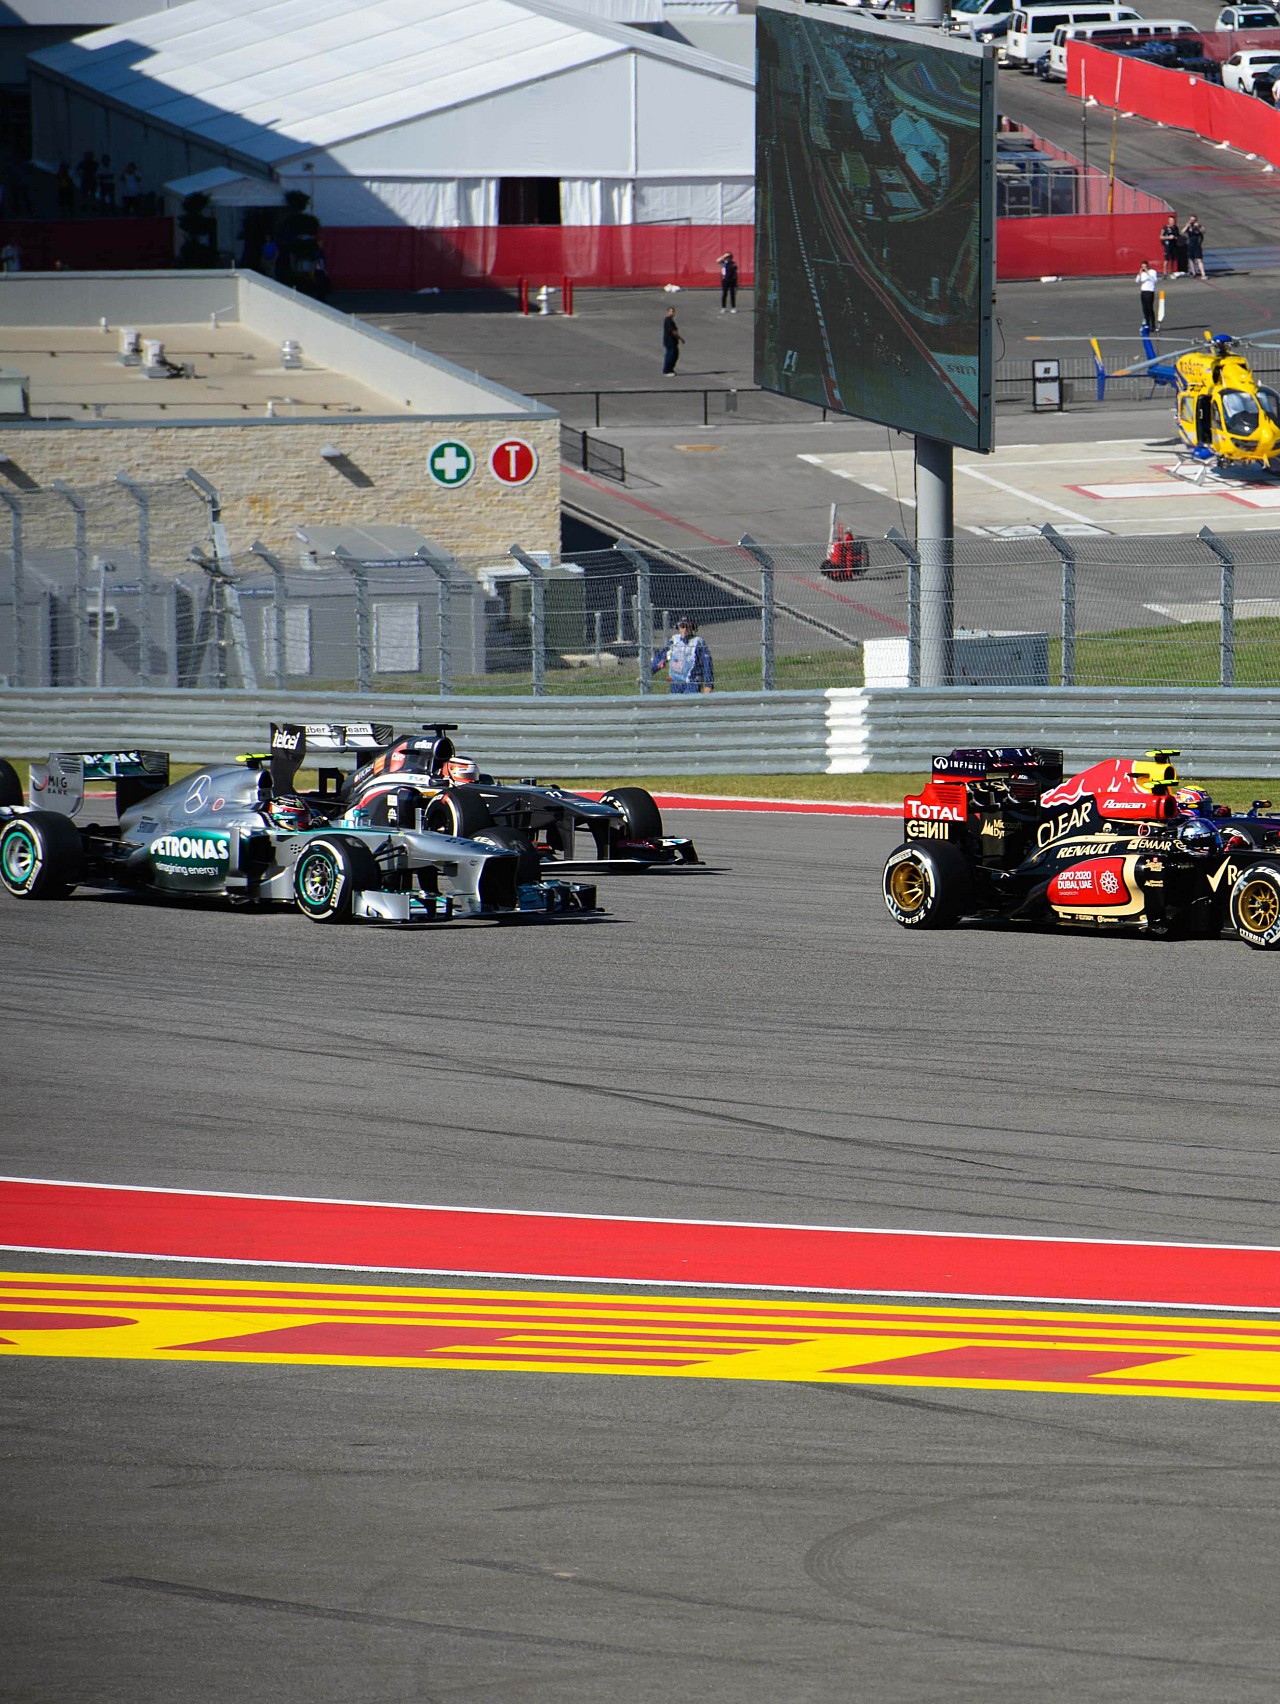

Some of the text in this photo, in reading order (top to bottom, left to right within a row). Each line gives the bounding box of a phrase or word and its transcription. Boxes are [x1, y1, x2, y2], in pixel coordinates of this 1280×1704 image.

[272, 729, 300, 750] telcel
[47, 775, 68, 788] MIG
[907, 800, 964, 822] TOTAL
[1037, 802, 1091, 848] CLEAR
[150, 836, 229, 860] PETRONAS
[1056, 842, 1116, 859] RENAULT
[1138, 839, 1172, 851] EMAAR
[189, 866, 219, 876] energy
[1058, 871, 1092, 880] EXPO 2020
[1080, 880, 1093, 889] UAE
